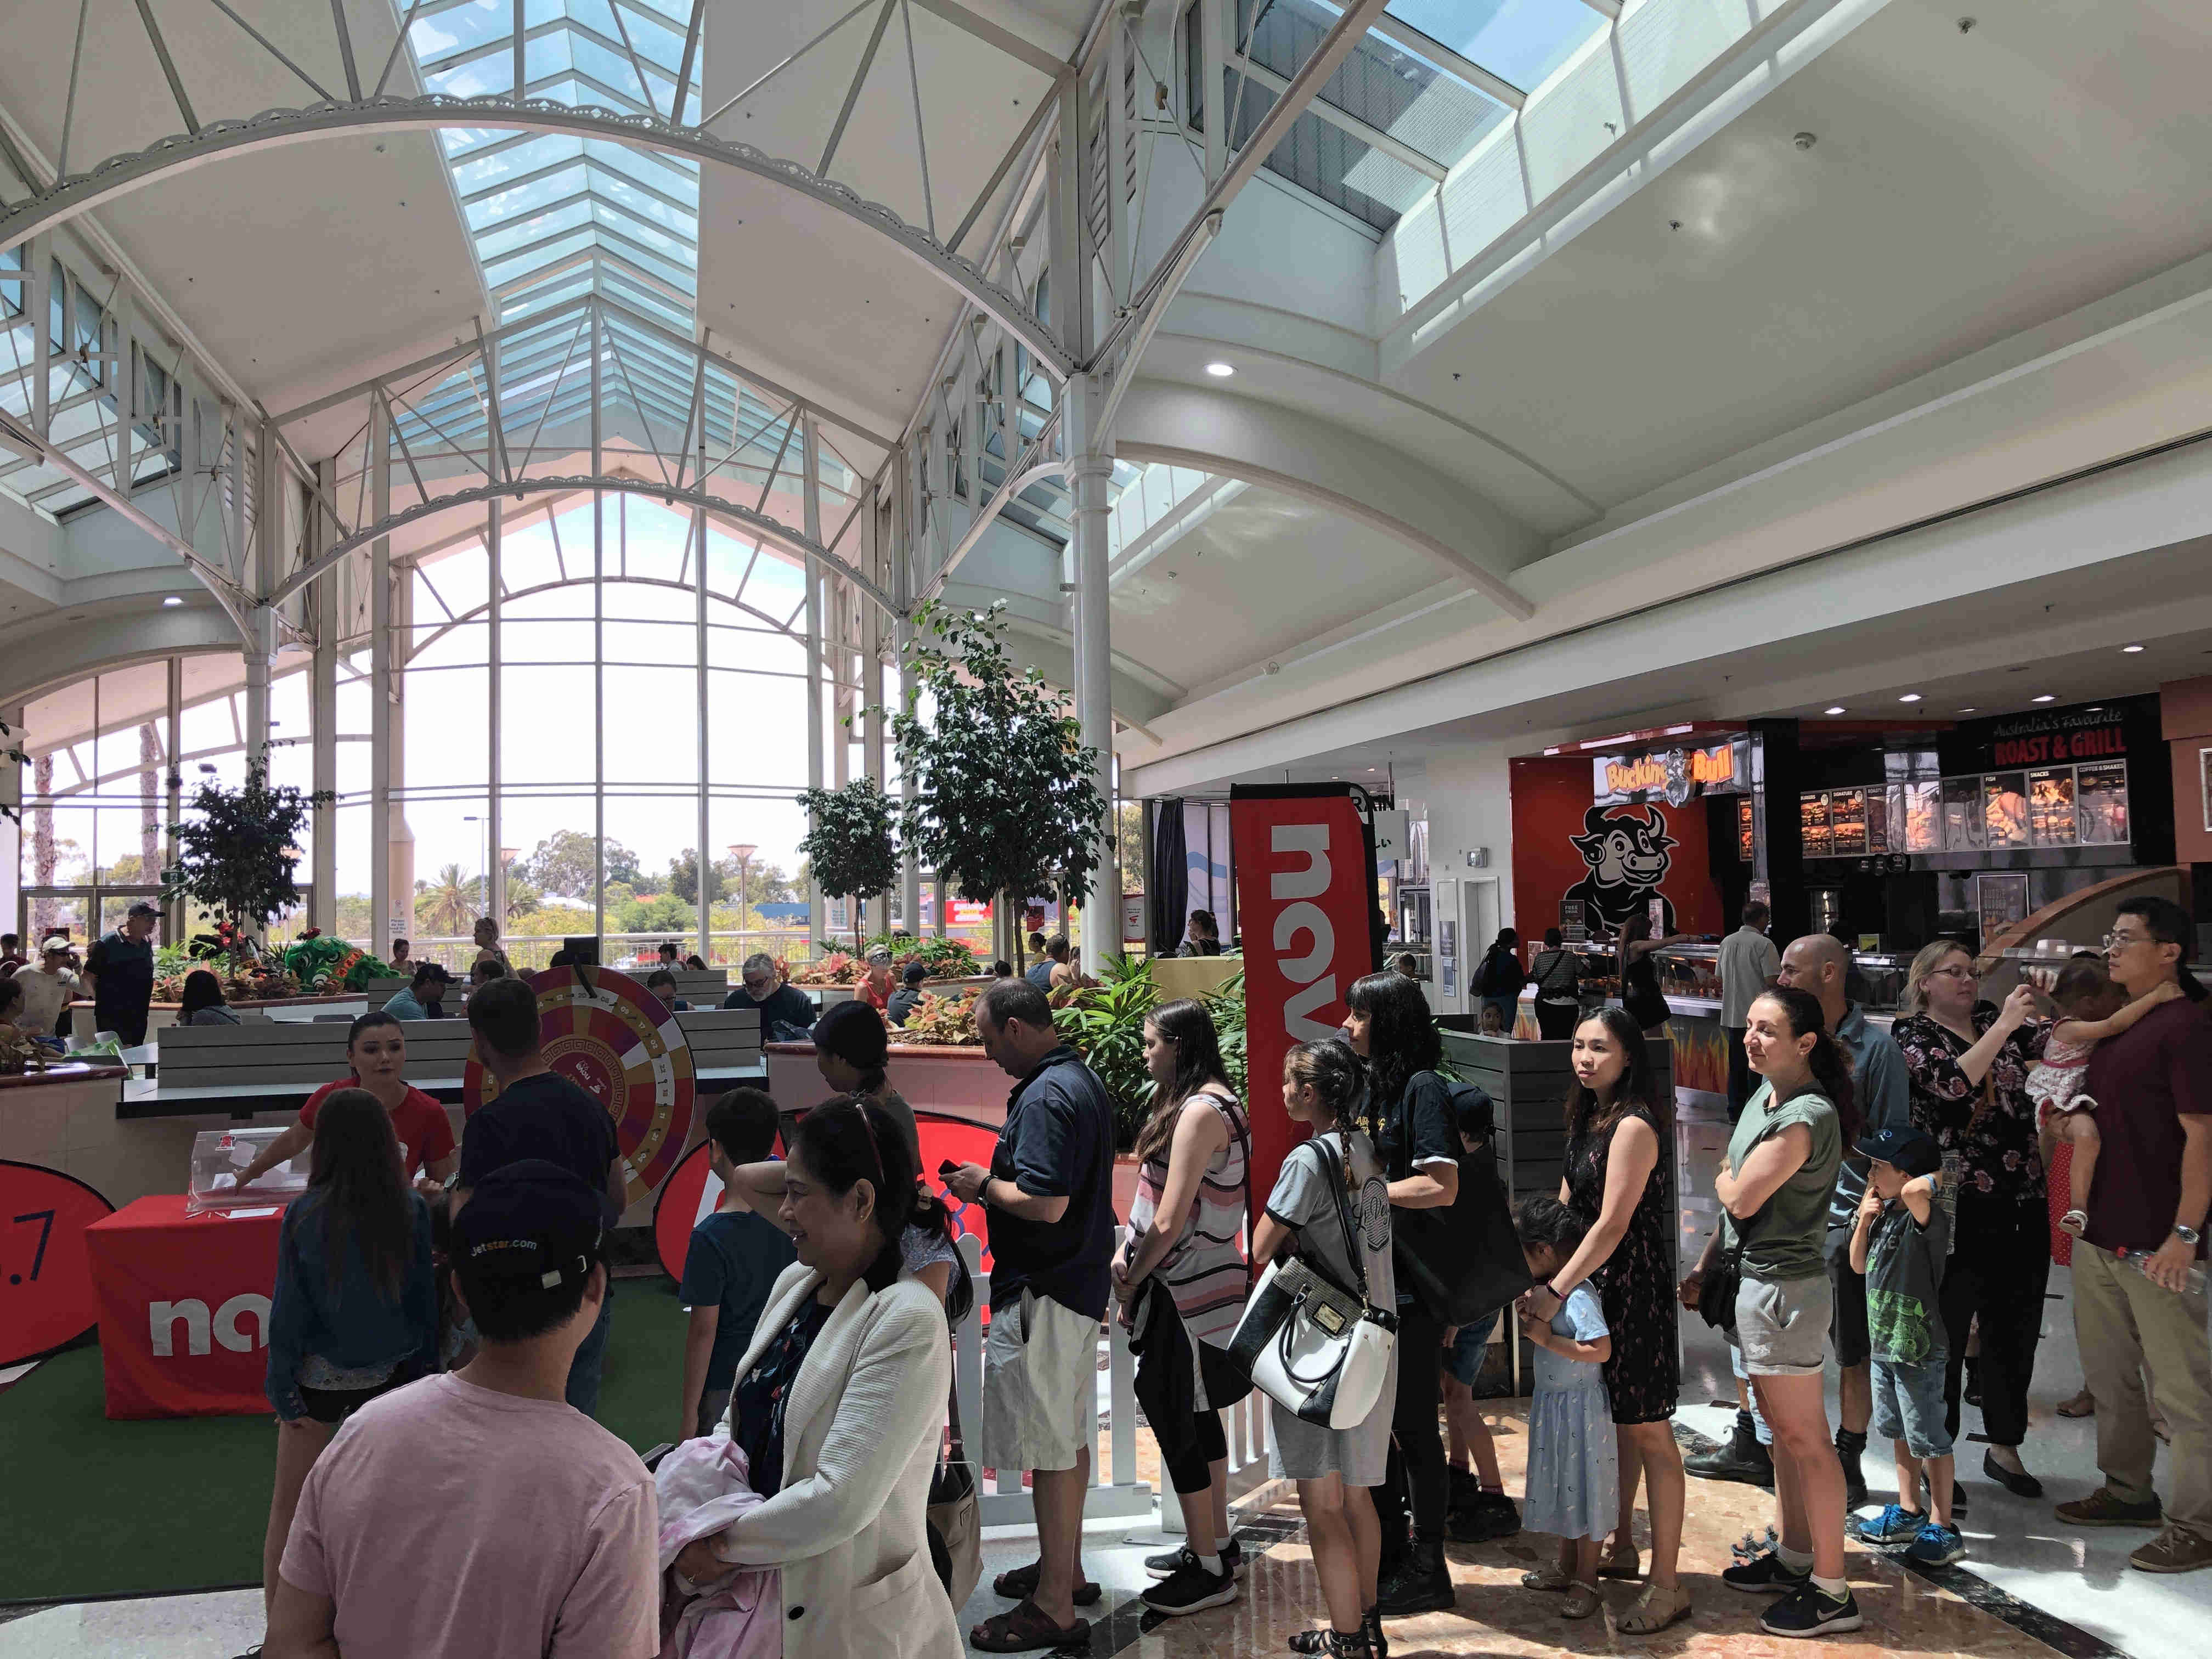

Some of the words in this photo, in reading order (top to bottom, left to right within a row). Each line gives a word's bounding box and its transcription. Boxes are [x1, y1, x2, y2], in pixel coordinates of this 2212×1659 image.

[1692, 744, 1733, 782] Bull
[1995, 737, 2050, 766] ROAST
[2053, 735, 2067, 759] &
[2072, 727, 2127, 756] GRILL
[650, 1039, 658, 1049] 02
